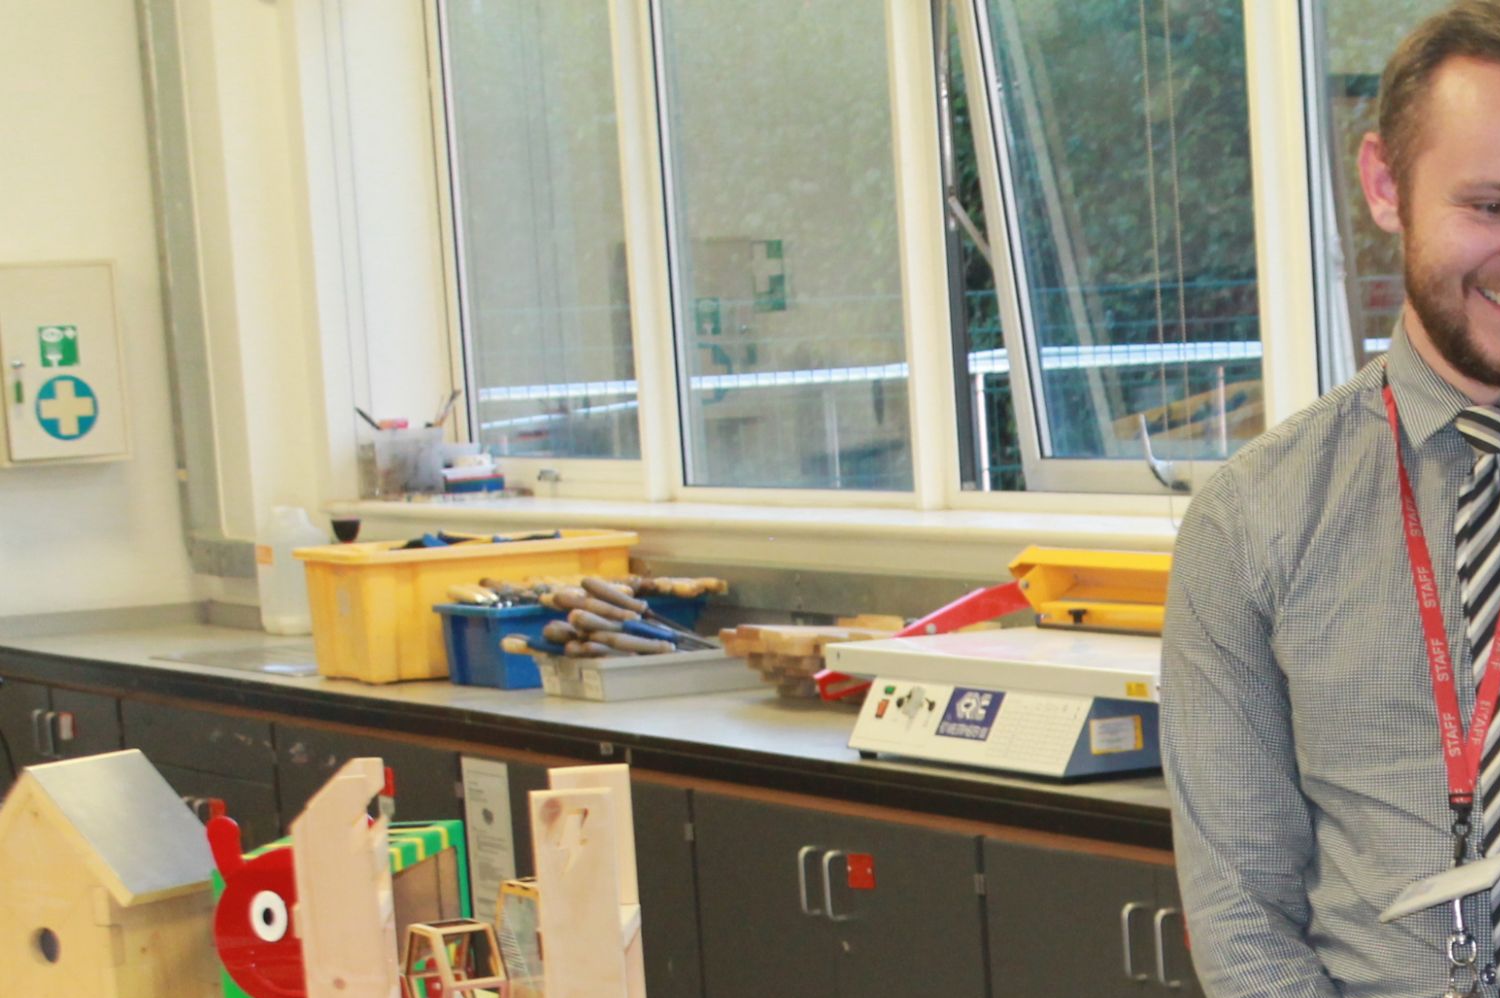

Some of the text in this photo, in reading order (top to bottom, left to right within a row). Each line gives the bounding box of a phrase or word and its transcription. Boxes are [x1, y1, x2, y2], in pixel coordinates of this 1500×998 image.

[1417, 566, 1436, 609] STAFF
[1431, 638, 1450, 682] STAFF
[1443, 712, 1461, 757] STAFF
